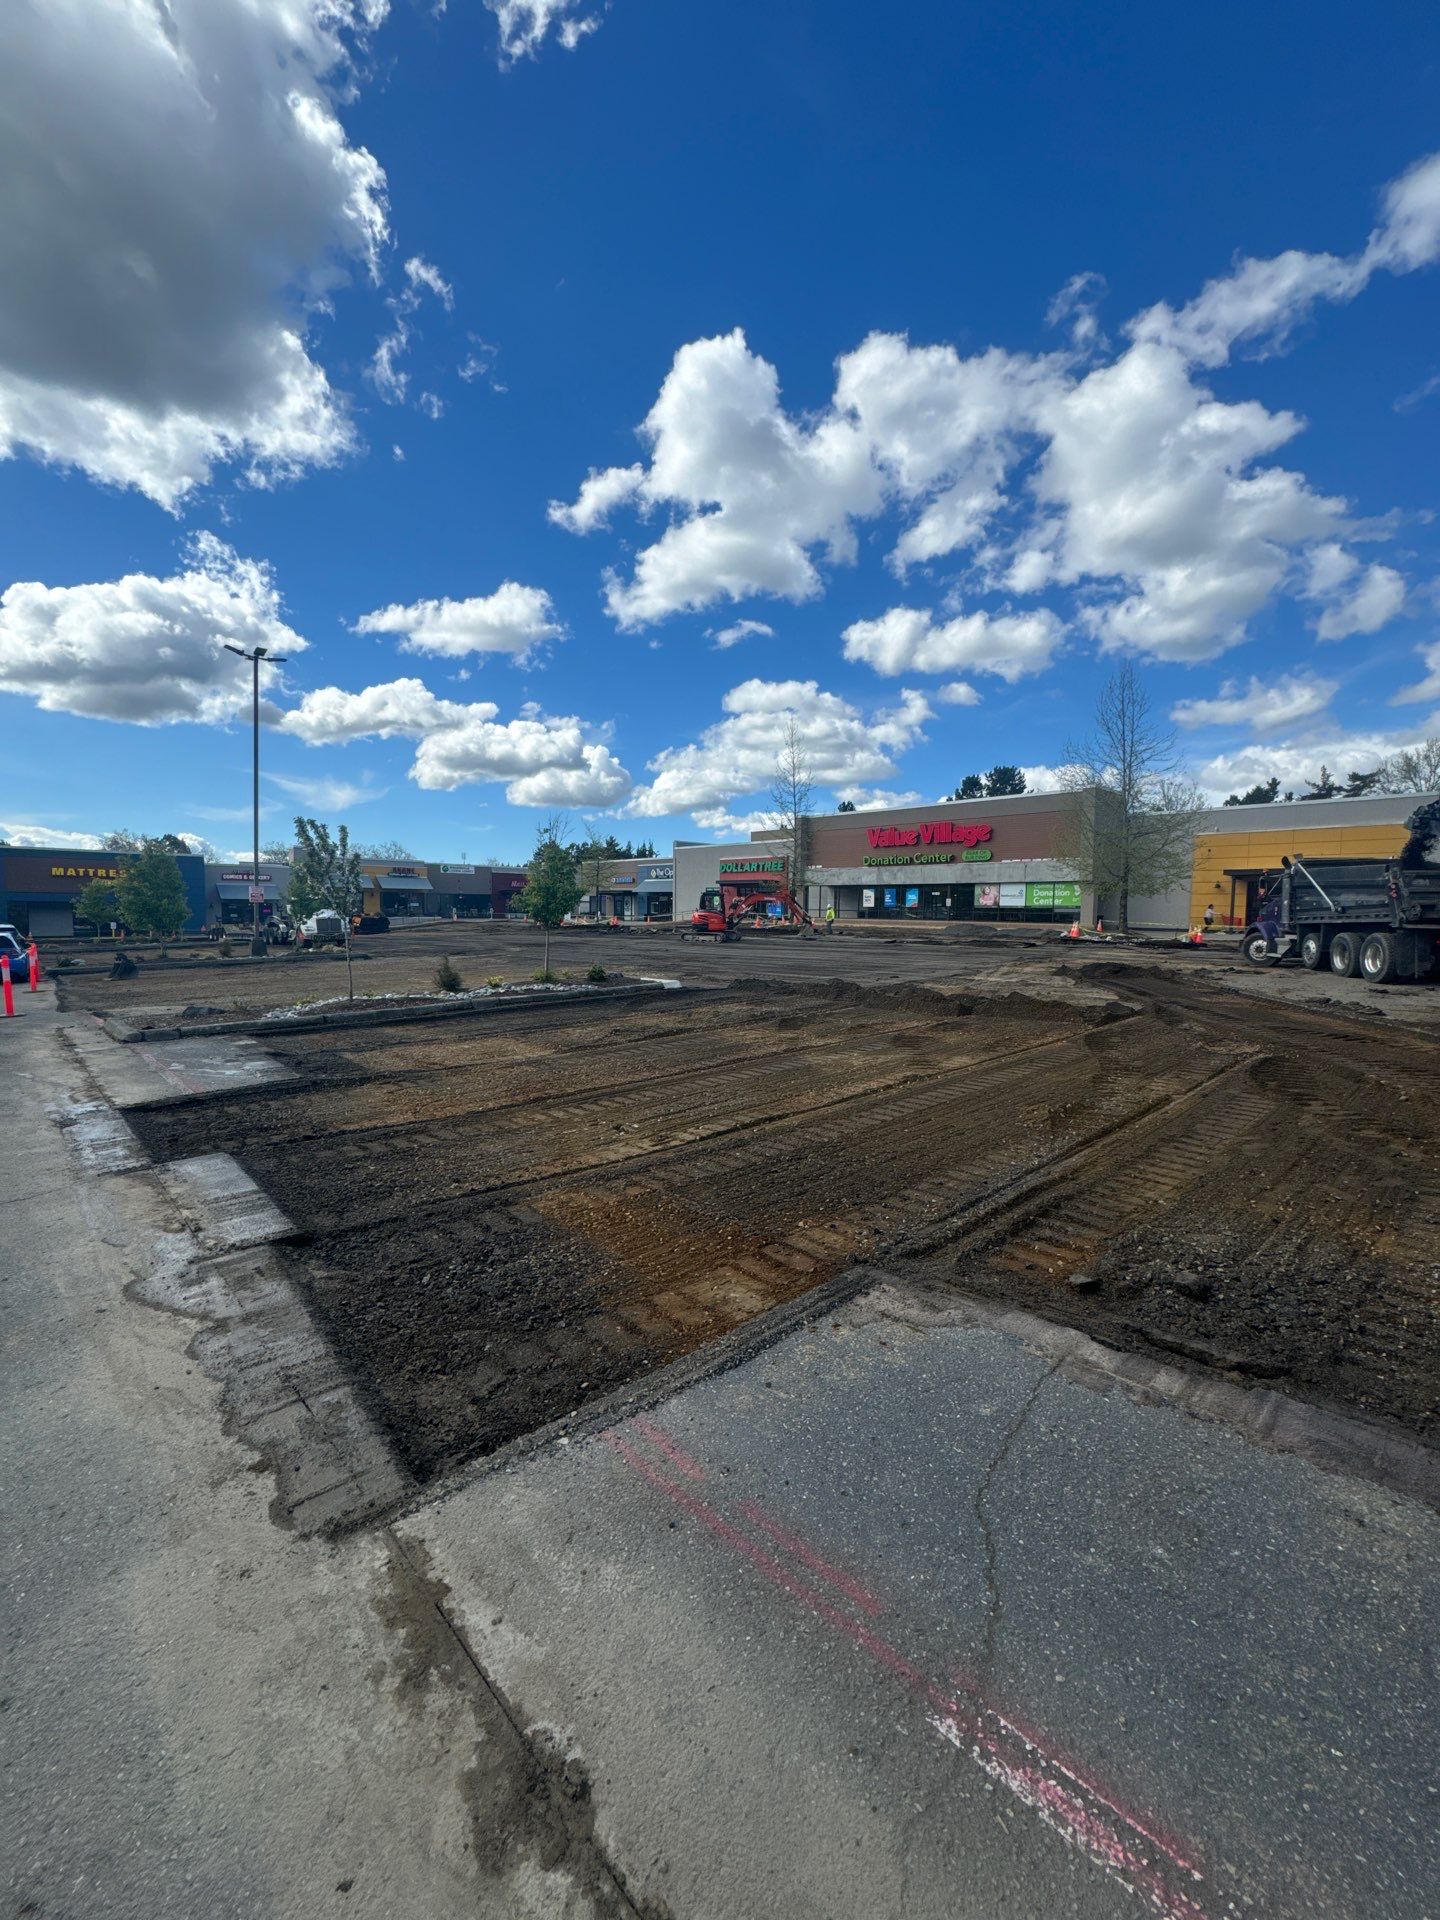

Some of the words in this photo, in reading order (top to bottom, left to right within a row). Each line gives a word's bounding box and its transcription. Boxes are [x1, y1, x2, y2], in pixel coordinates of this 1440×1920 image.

[866, 827, 918, 848] Value
[920, 821, 992, 847] Village
[863, 855, 910, 866] Donation
[913, 852, 953, 863] Center
[51, 867, 127, 877] MATTRES
[720, 863, 757, 872] DOLLAR
[759, 861, 784, 871] TREE
